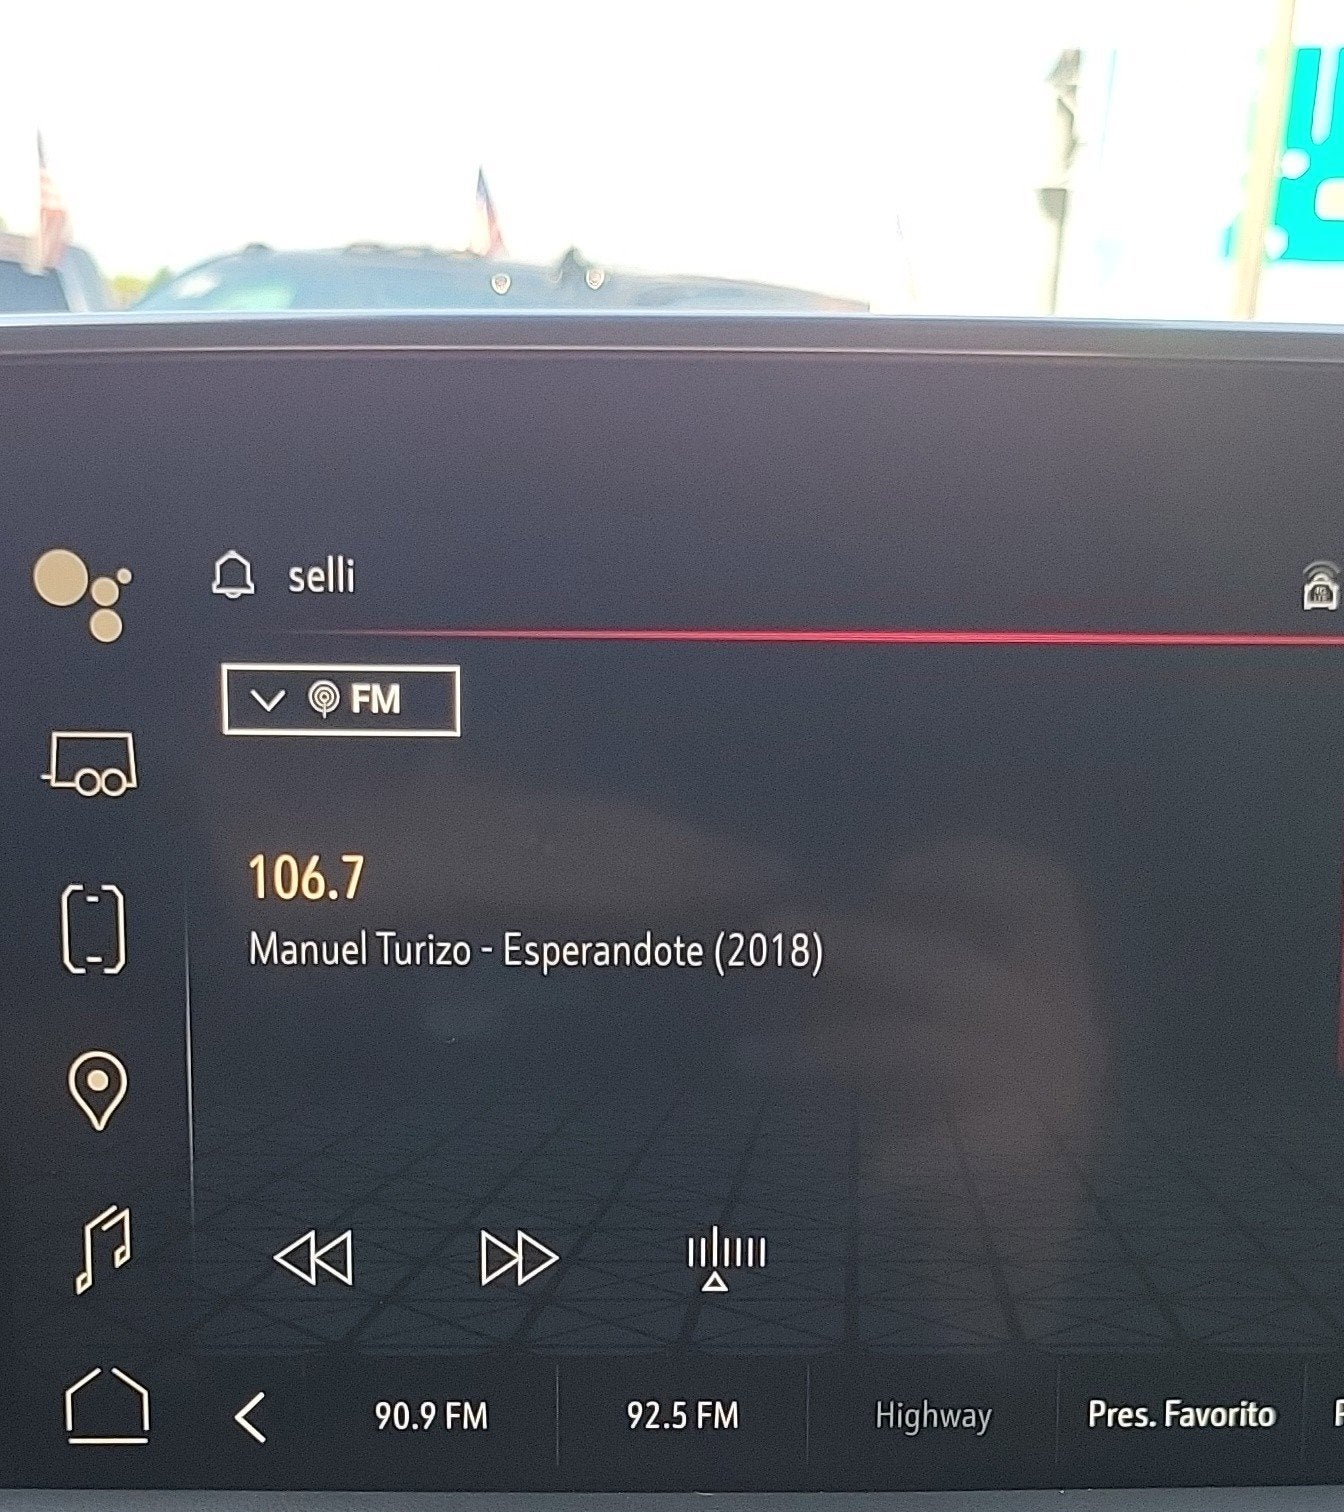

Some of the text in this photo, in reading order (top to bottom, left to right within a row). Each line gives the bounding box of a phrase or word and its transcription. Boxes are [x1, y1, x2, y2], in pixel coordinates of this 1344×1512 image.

[288, 553, 355, 594] selli
[350, 682, 401, 715] FM
[249, 853, 365, 901] 106.7
[249, 928, 368, 967] Manuel
[374, 930, 472, 967] Turizo
[503, 929, 705, 977] Esperandote
[714, 930, 825, 978] (2018)
[374, 1400, 489, 1431] 90.9 FM
[626, 1400, 739, 1430] 92.5 FM
[875, 1398, 994, 1437] Highway
[1088, 1398, 1278, 1428] Pres. Favorito
